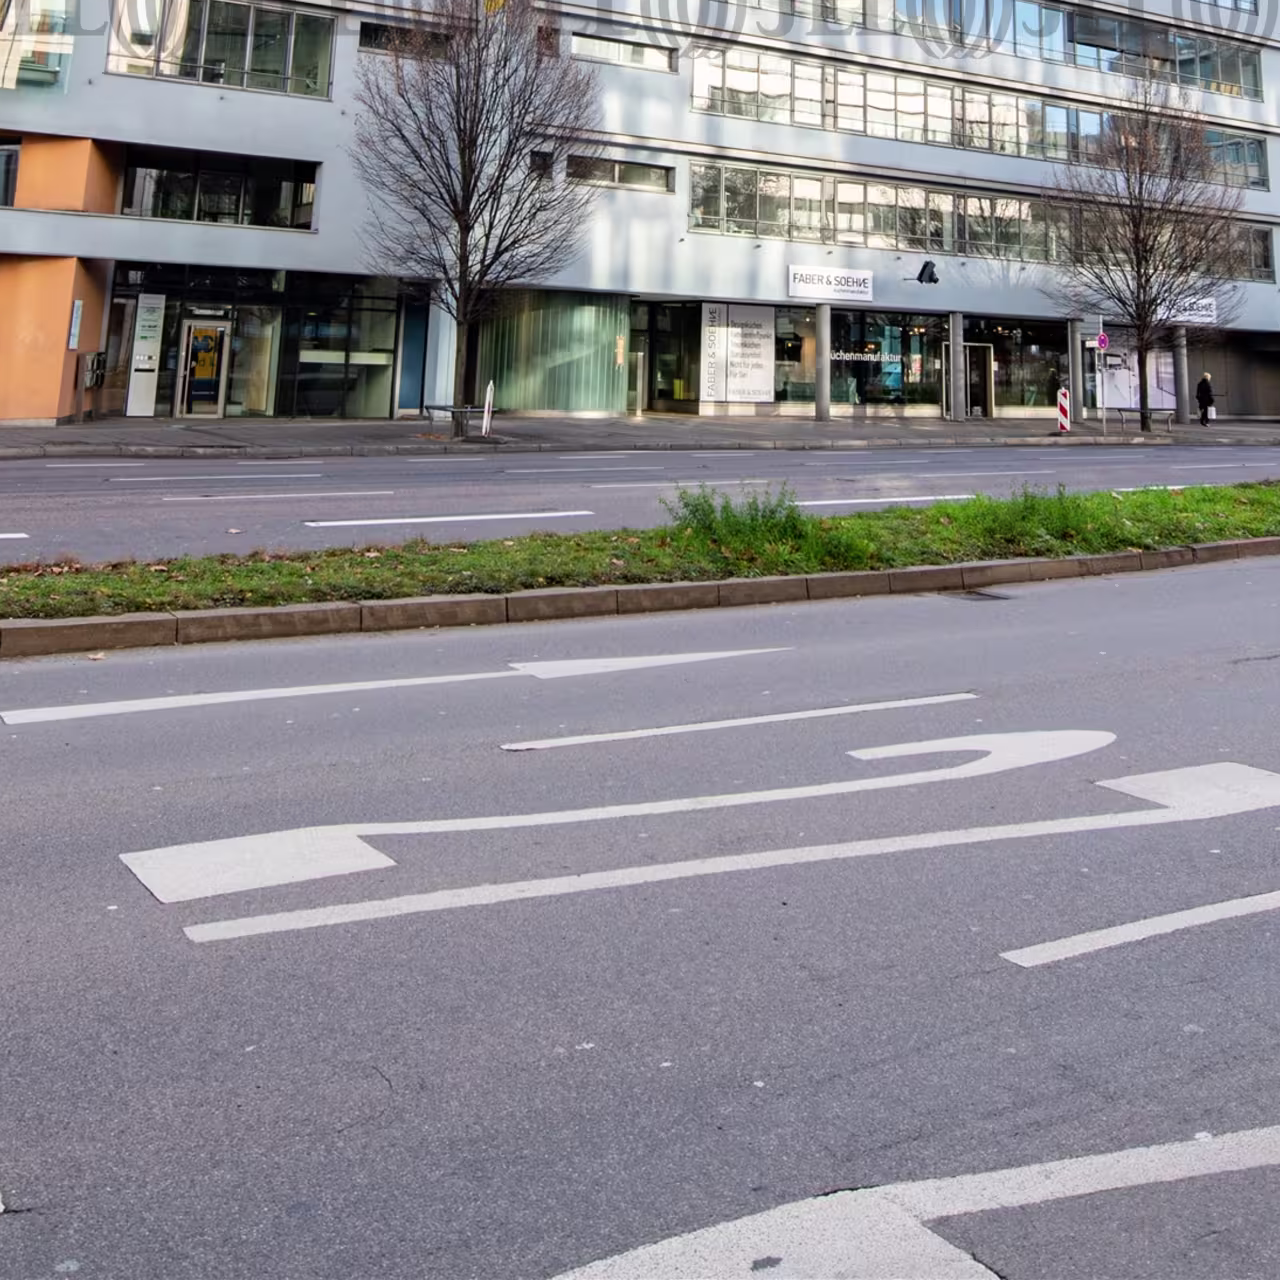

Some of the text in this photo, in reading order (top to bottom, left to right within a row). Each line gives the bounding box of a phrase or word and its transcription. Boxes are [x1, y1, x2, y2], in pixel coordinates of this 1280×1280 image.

[793, 272, 869, 289] FABER & SOEHNE
[707, 307, 717, 397] FABER & SOEHNE
[830, 349, 902, 361] üchenmanufaktur
